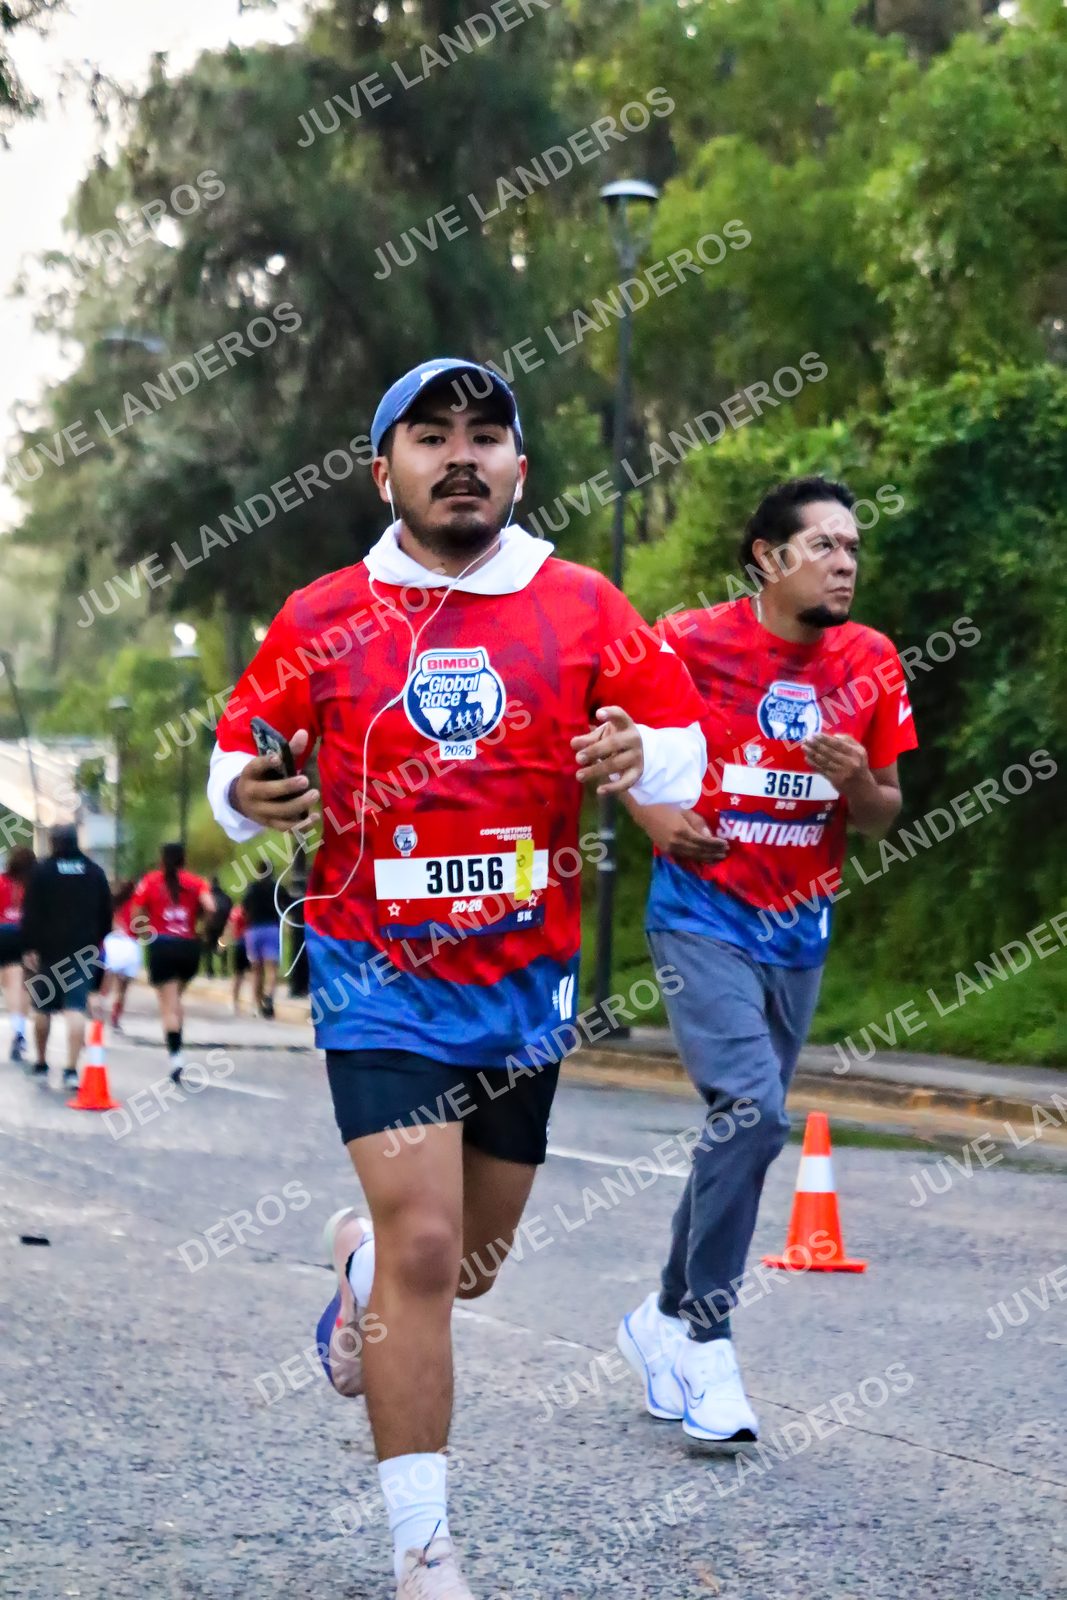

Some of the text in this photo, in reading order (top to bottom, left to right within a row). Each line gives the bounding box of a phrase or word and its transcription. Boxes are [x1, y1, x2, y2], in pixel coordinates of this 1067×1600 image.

[427, 657, 479, 671] BIMBO
[428, 672, 480, 693] Global
[420, 691, 461, 708] Race
[444, 744, 472, 757] 2026
[764, 772, 813, 799] 3651
[716, 818, 825, 848] SANTIAGO
[426, 856, 504, 894] 3056
[517, 910, 533, 923] 5K
